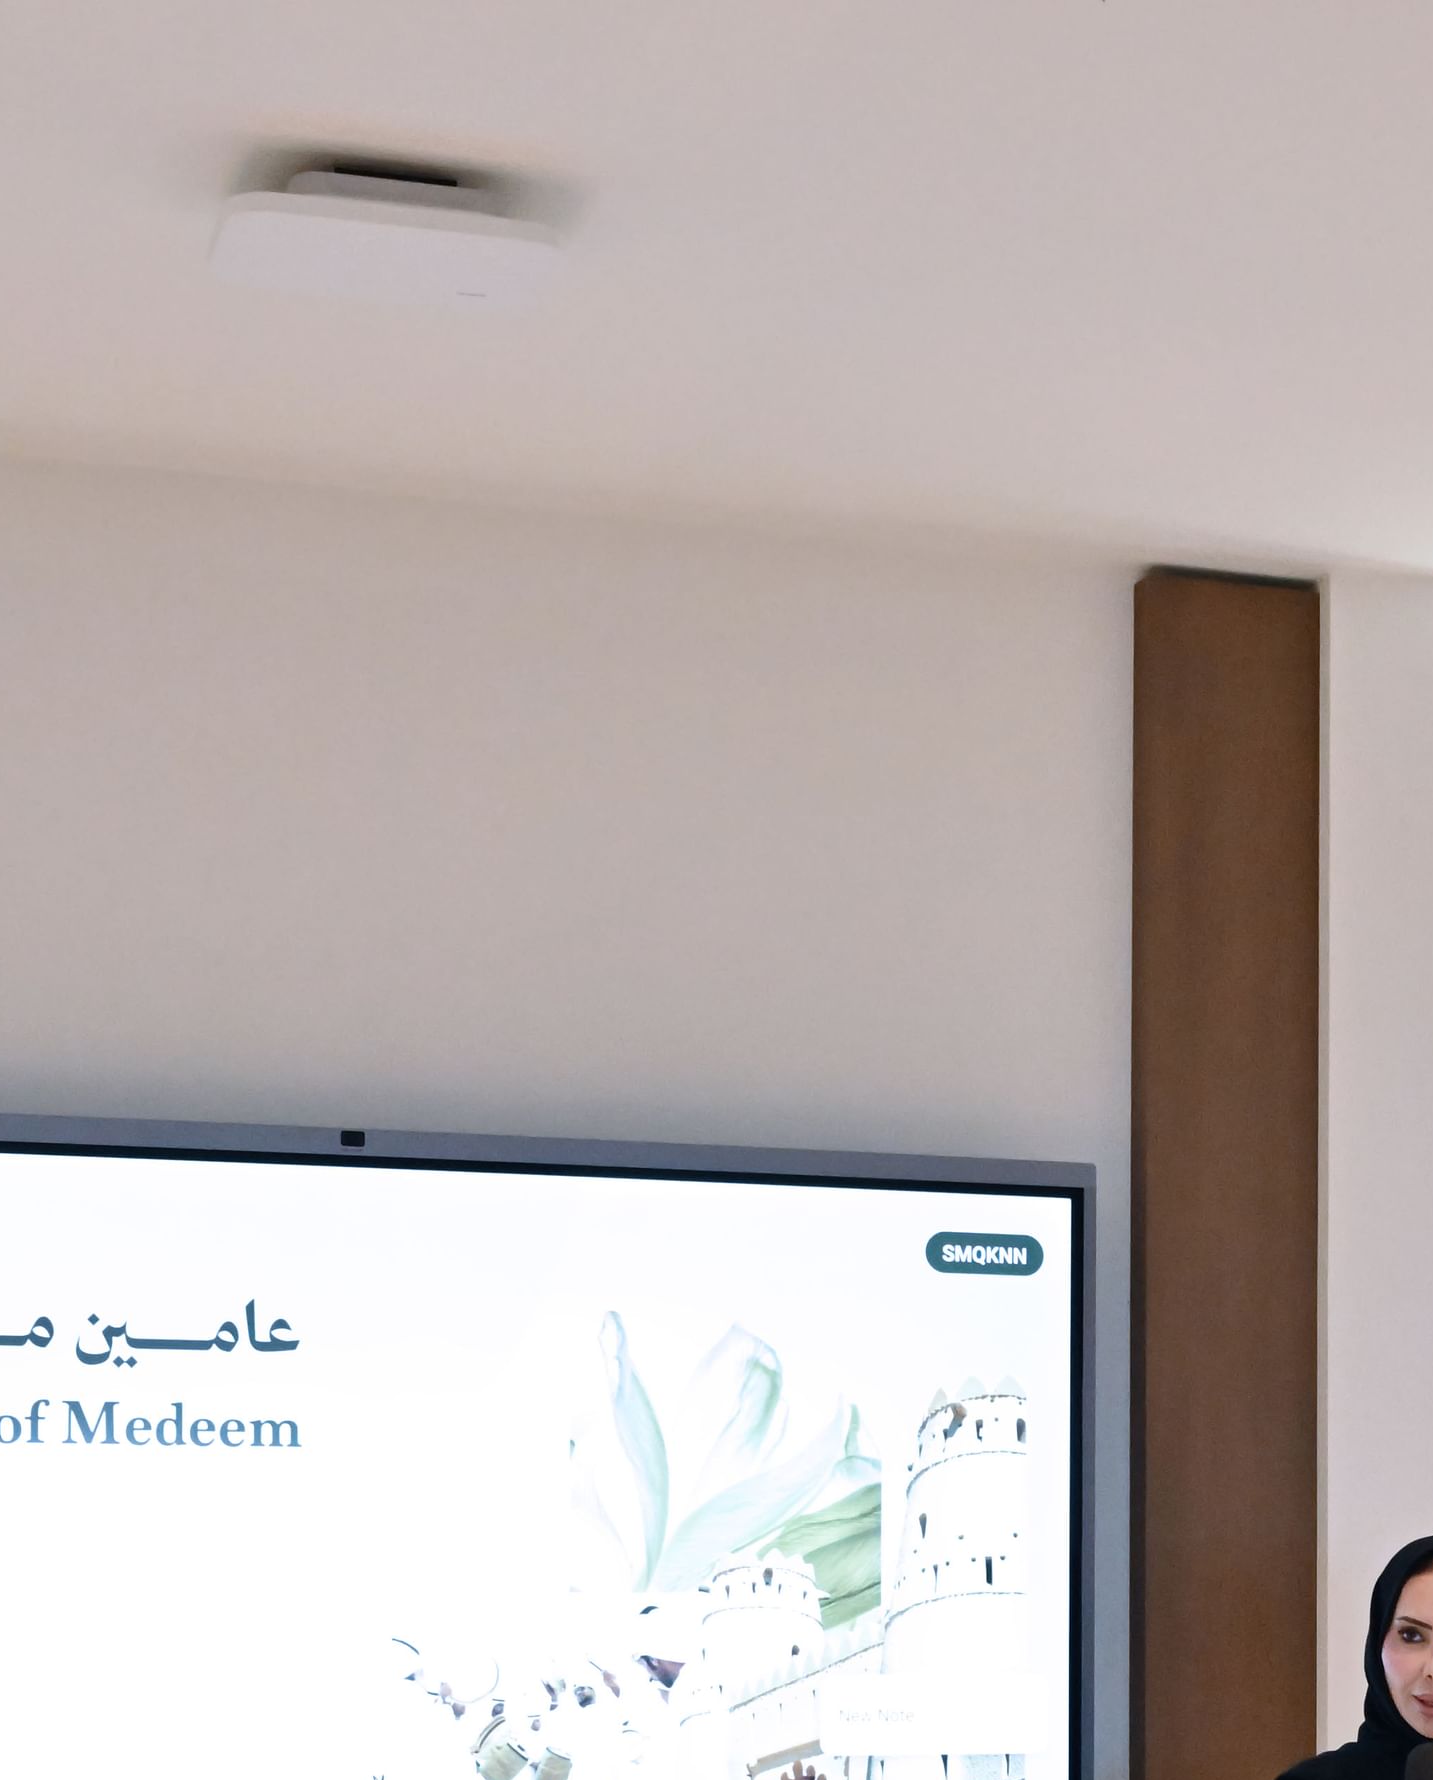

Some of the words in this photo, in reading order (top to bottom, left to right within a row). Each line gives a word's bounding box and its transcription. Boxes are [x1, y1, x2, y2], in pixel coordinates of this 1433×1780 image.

[941, 1243, 1027, 1265] SMQKNN
[75, 1298, 301, 1368] عامين
[62, 1400, 303, 1448] Medeem
